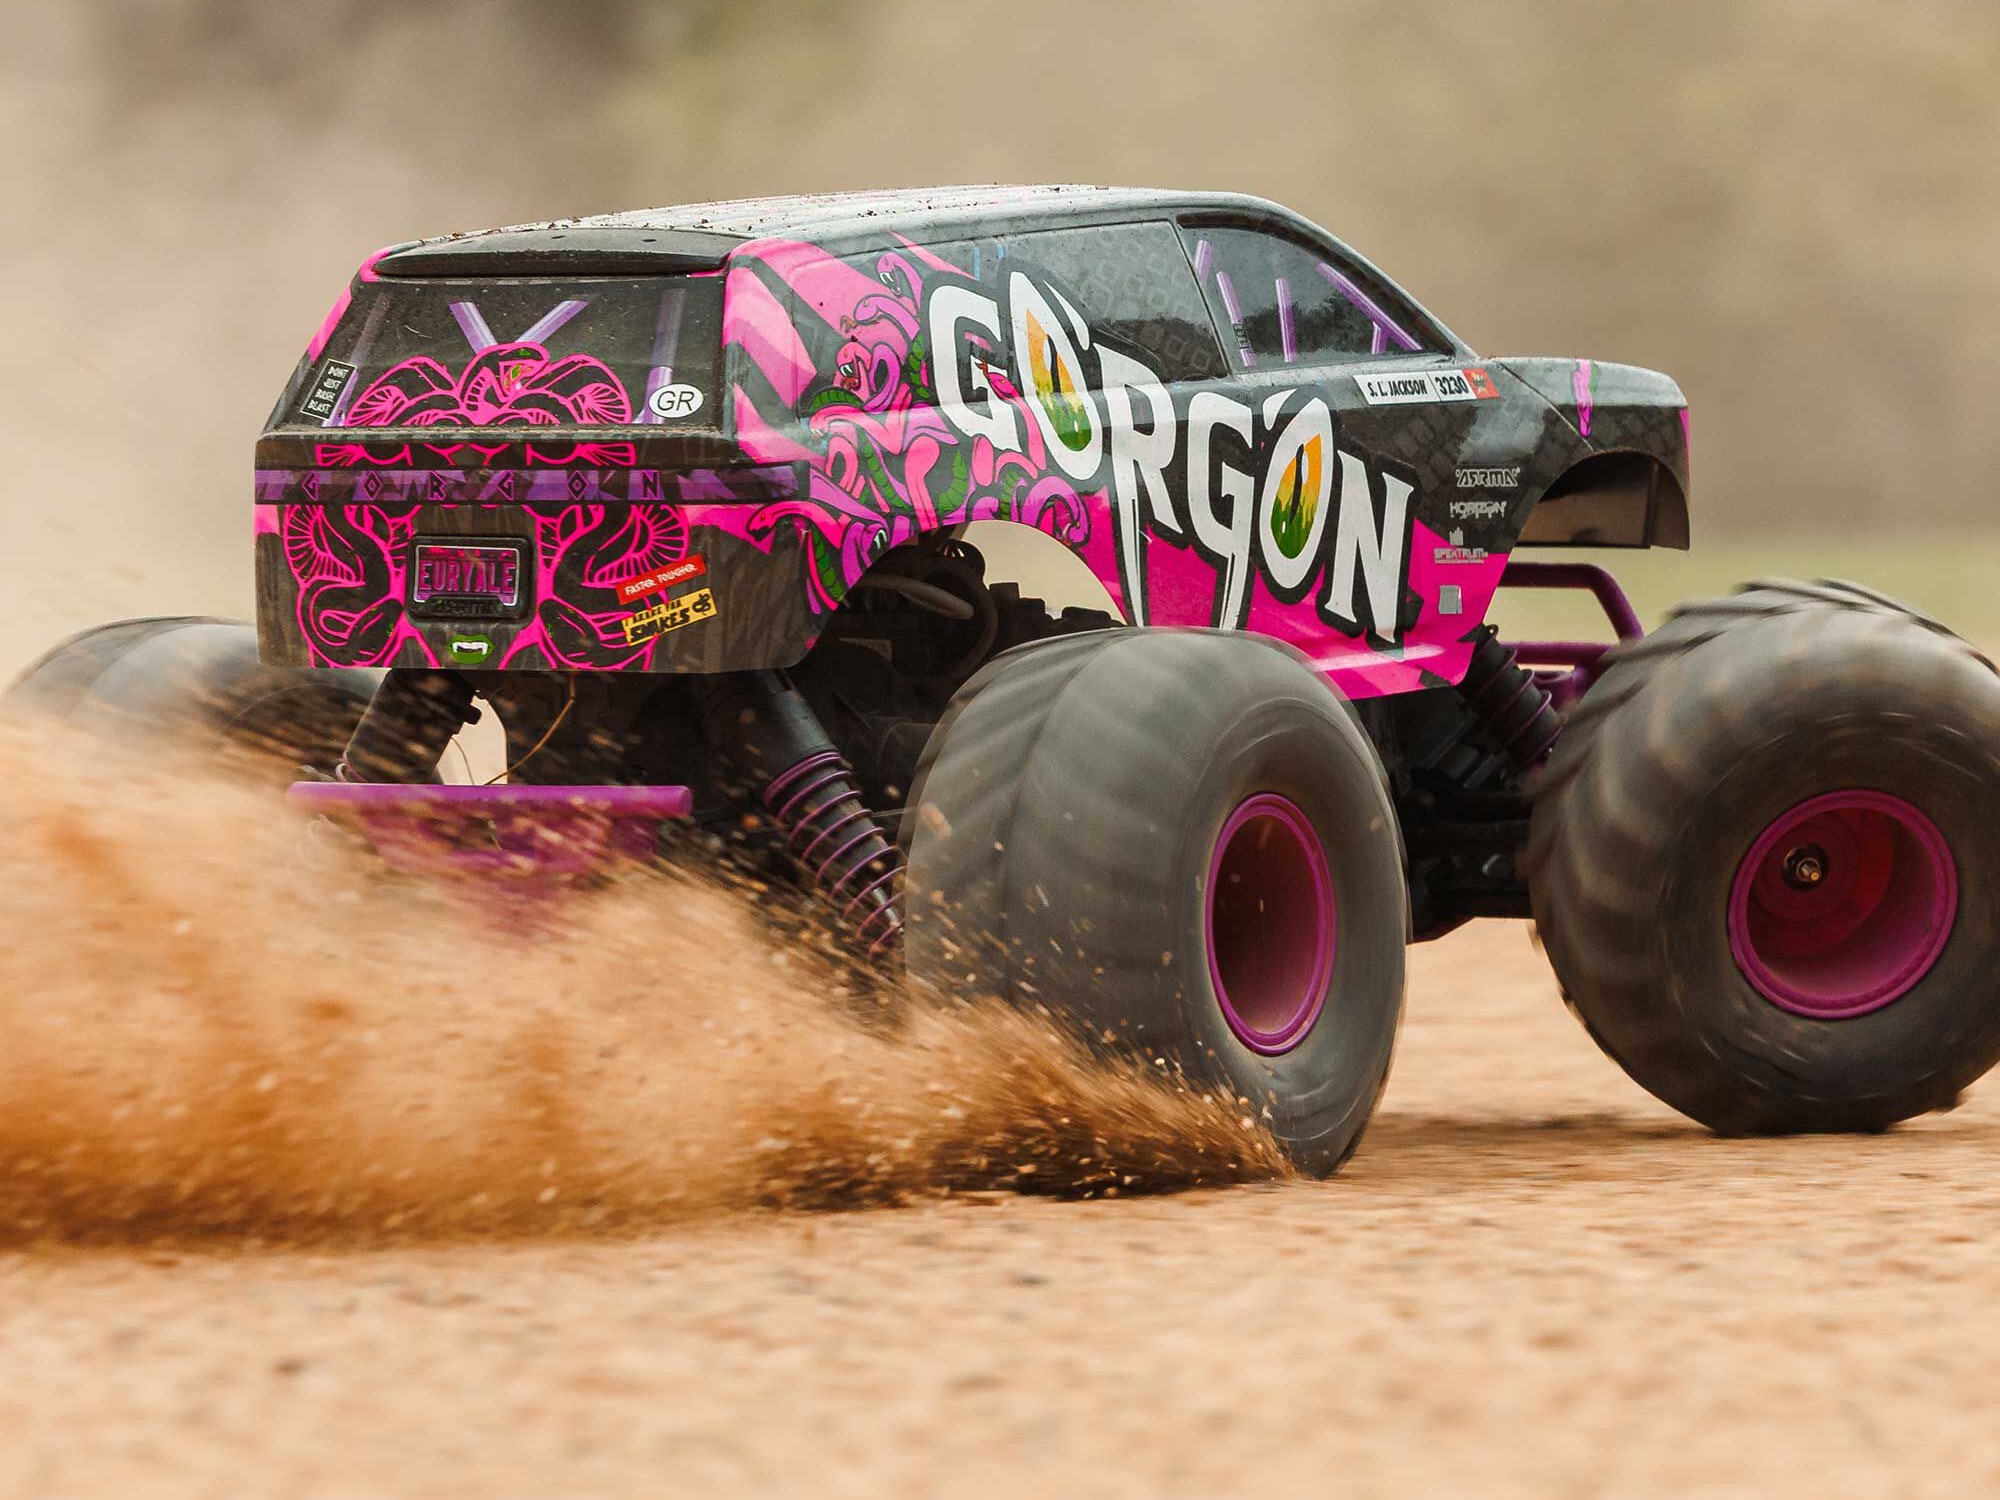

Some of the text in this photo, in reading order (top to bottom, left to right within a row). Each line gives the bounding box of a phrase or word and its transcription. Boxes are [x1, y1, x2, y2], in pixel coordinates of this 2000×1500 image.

[656, 390, 694, 411] GR
[1388, 379, 1428, 396] JACKSON
[1435, 375, 1469, 396] 3230
[928, 271, 1414, 643] GORGON
[417, 559, 517, 594] EURYALE
[628, 606, 690, 642] SNAKES
